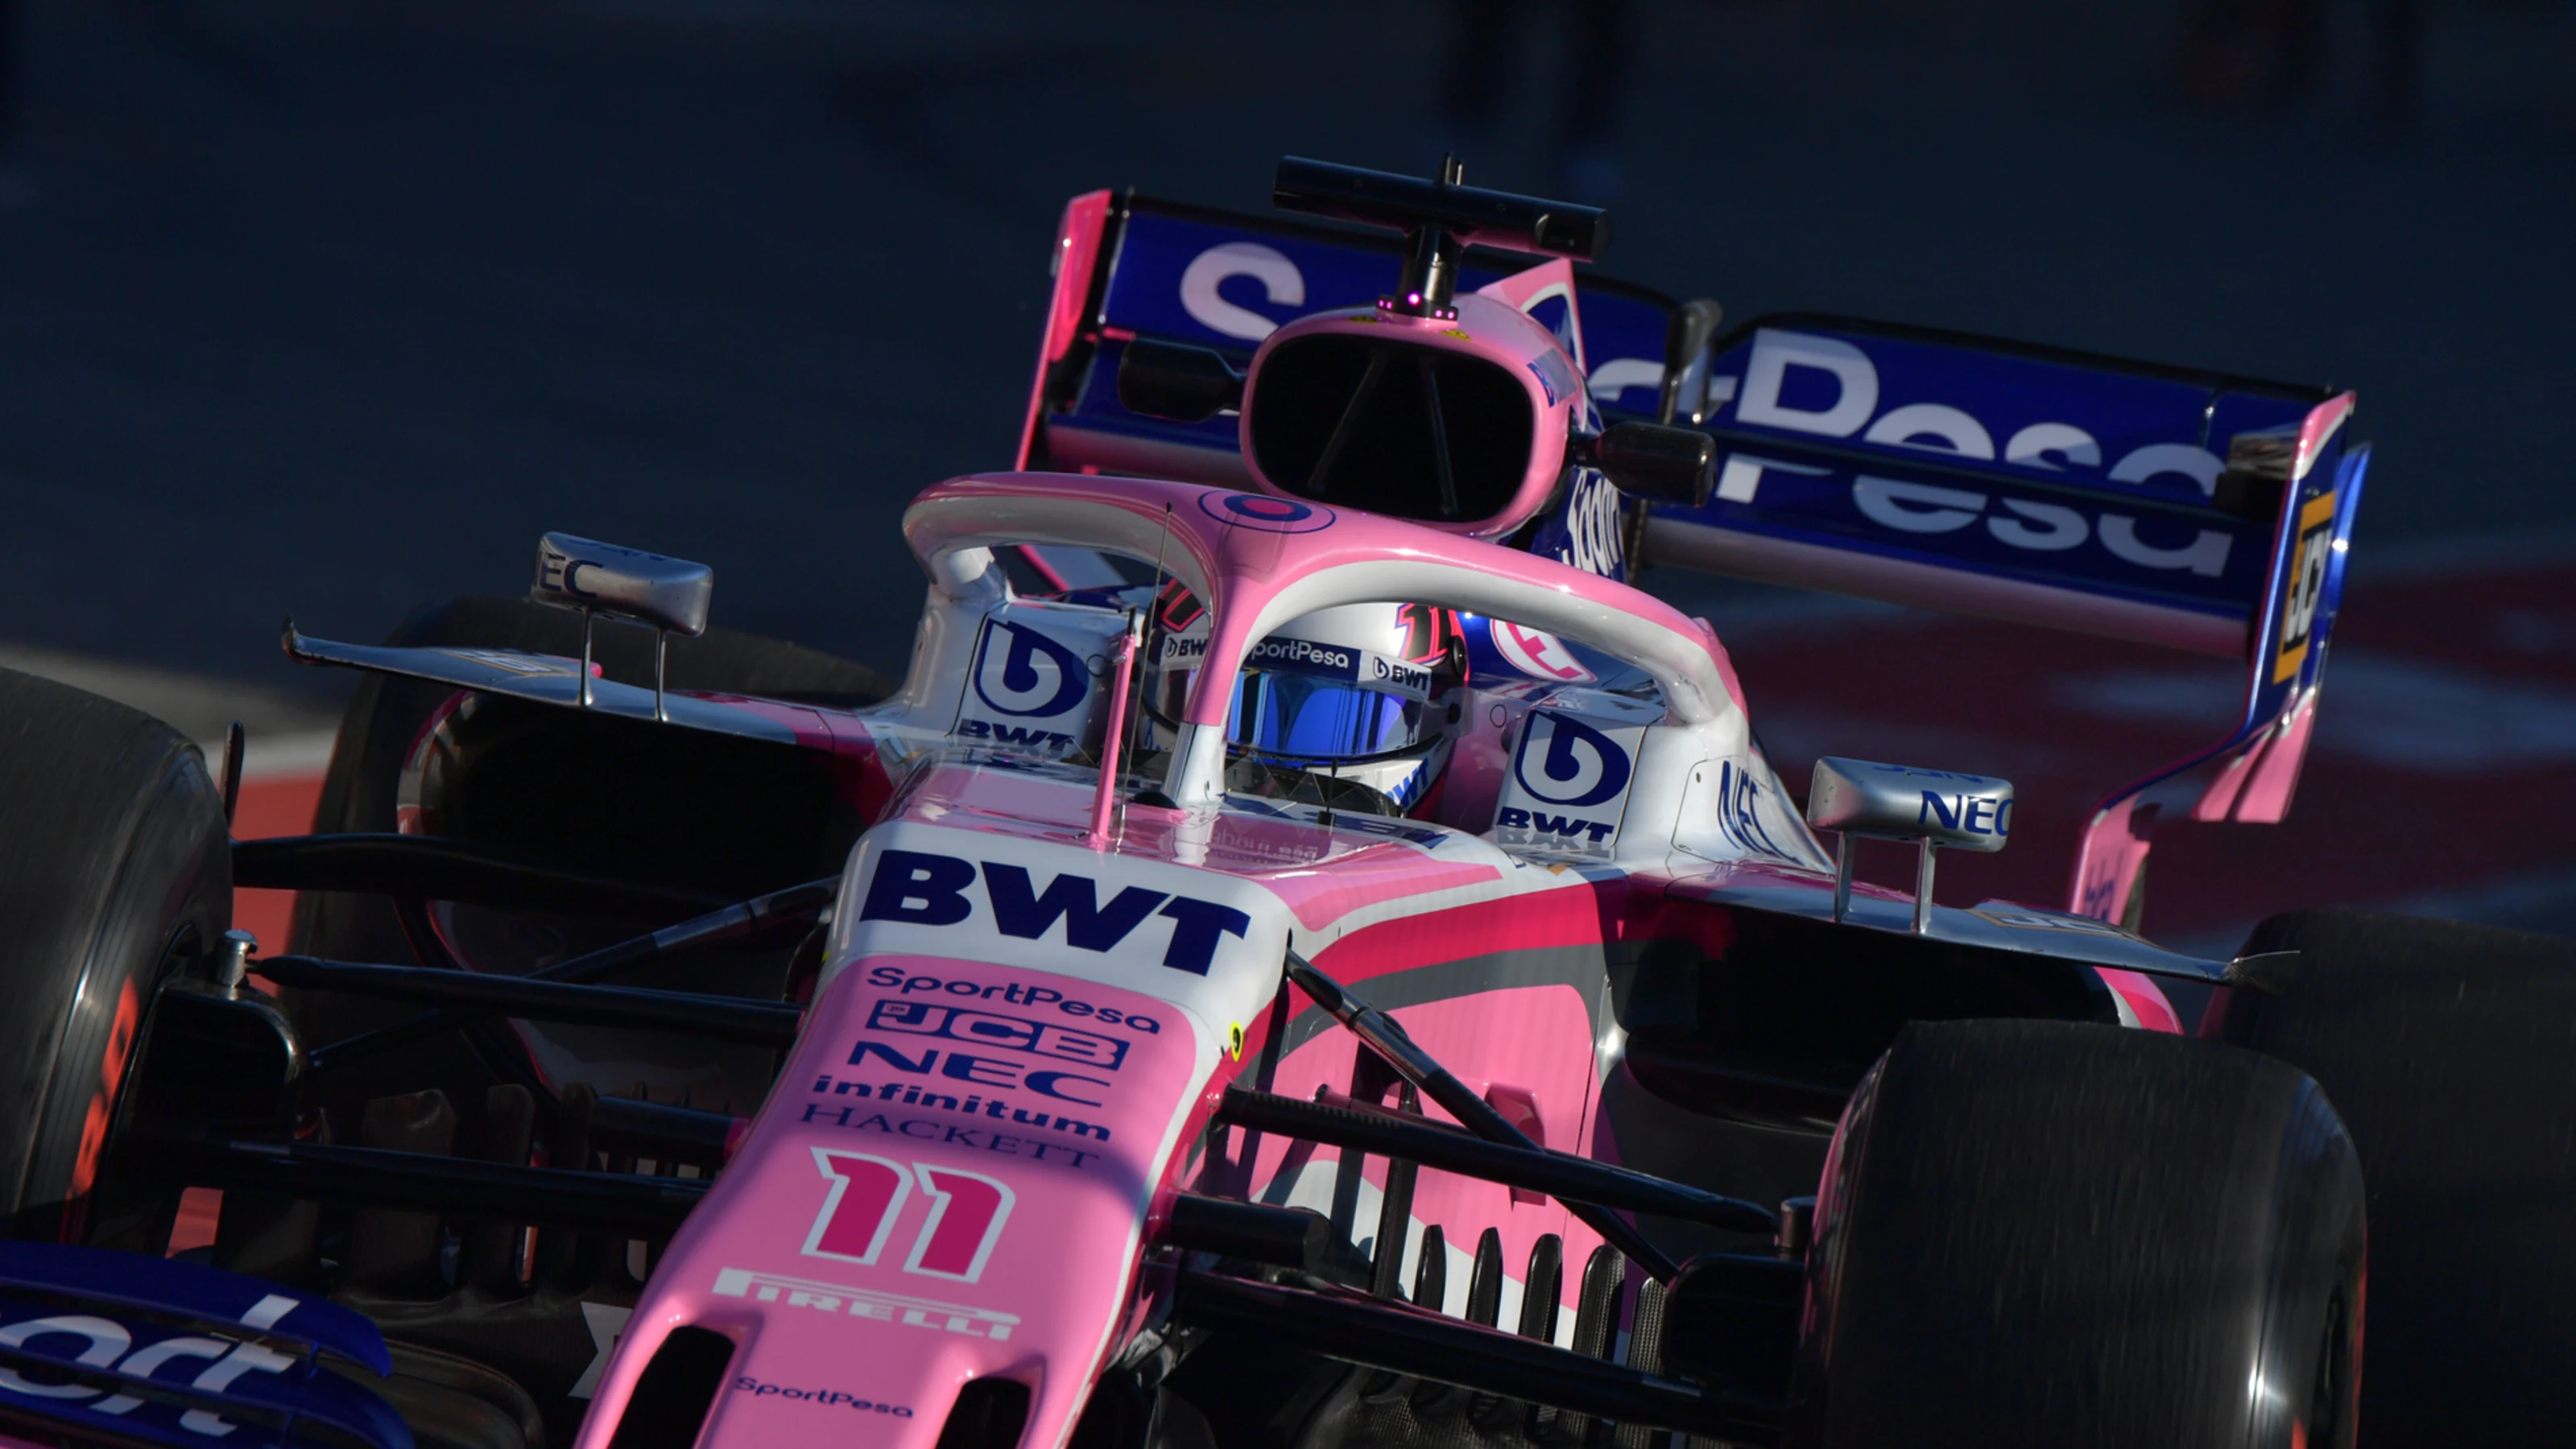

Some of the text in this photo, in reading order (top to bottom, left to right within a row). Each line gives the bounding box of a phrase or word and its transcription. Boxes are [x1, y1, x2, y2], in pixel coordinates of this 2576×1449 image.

[535, 551, 603, 598] EC
[1178, 639, 1209, 657] BW
[1250, 642, 1350, 670] portPesa
[1391, 665, 1429, 691] BWT
[958, 718, 1074, 750] BWT
[1497, 807, 1615, 842] BWT
[860, 850, 1251, 976] BWT
[867, 968, 1160, 1034] SportPesa
[866, 1000, 1130, 1071] JCB
[847, 1041, 1110, 1108] NEC
[800, 1103, 1100, 1168] HACKETT
[813, 1075, 1111, 1141] infinitum
[800, 1146, 1016, 1285] 11
[712, 1267, 1022, 1341] PIRELLI
[734, 1377, 914, 1418] SportPesa
